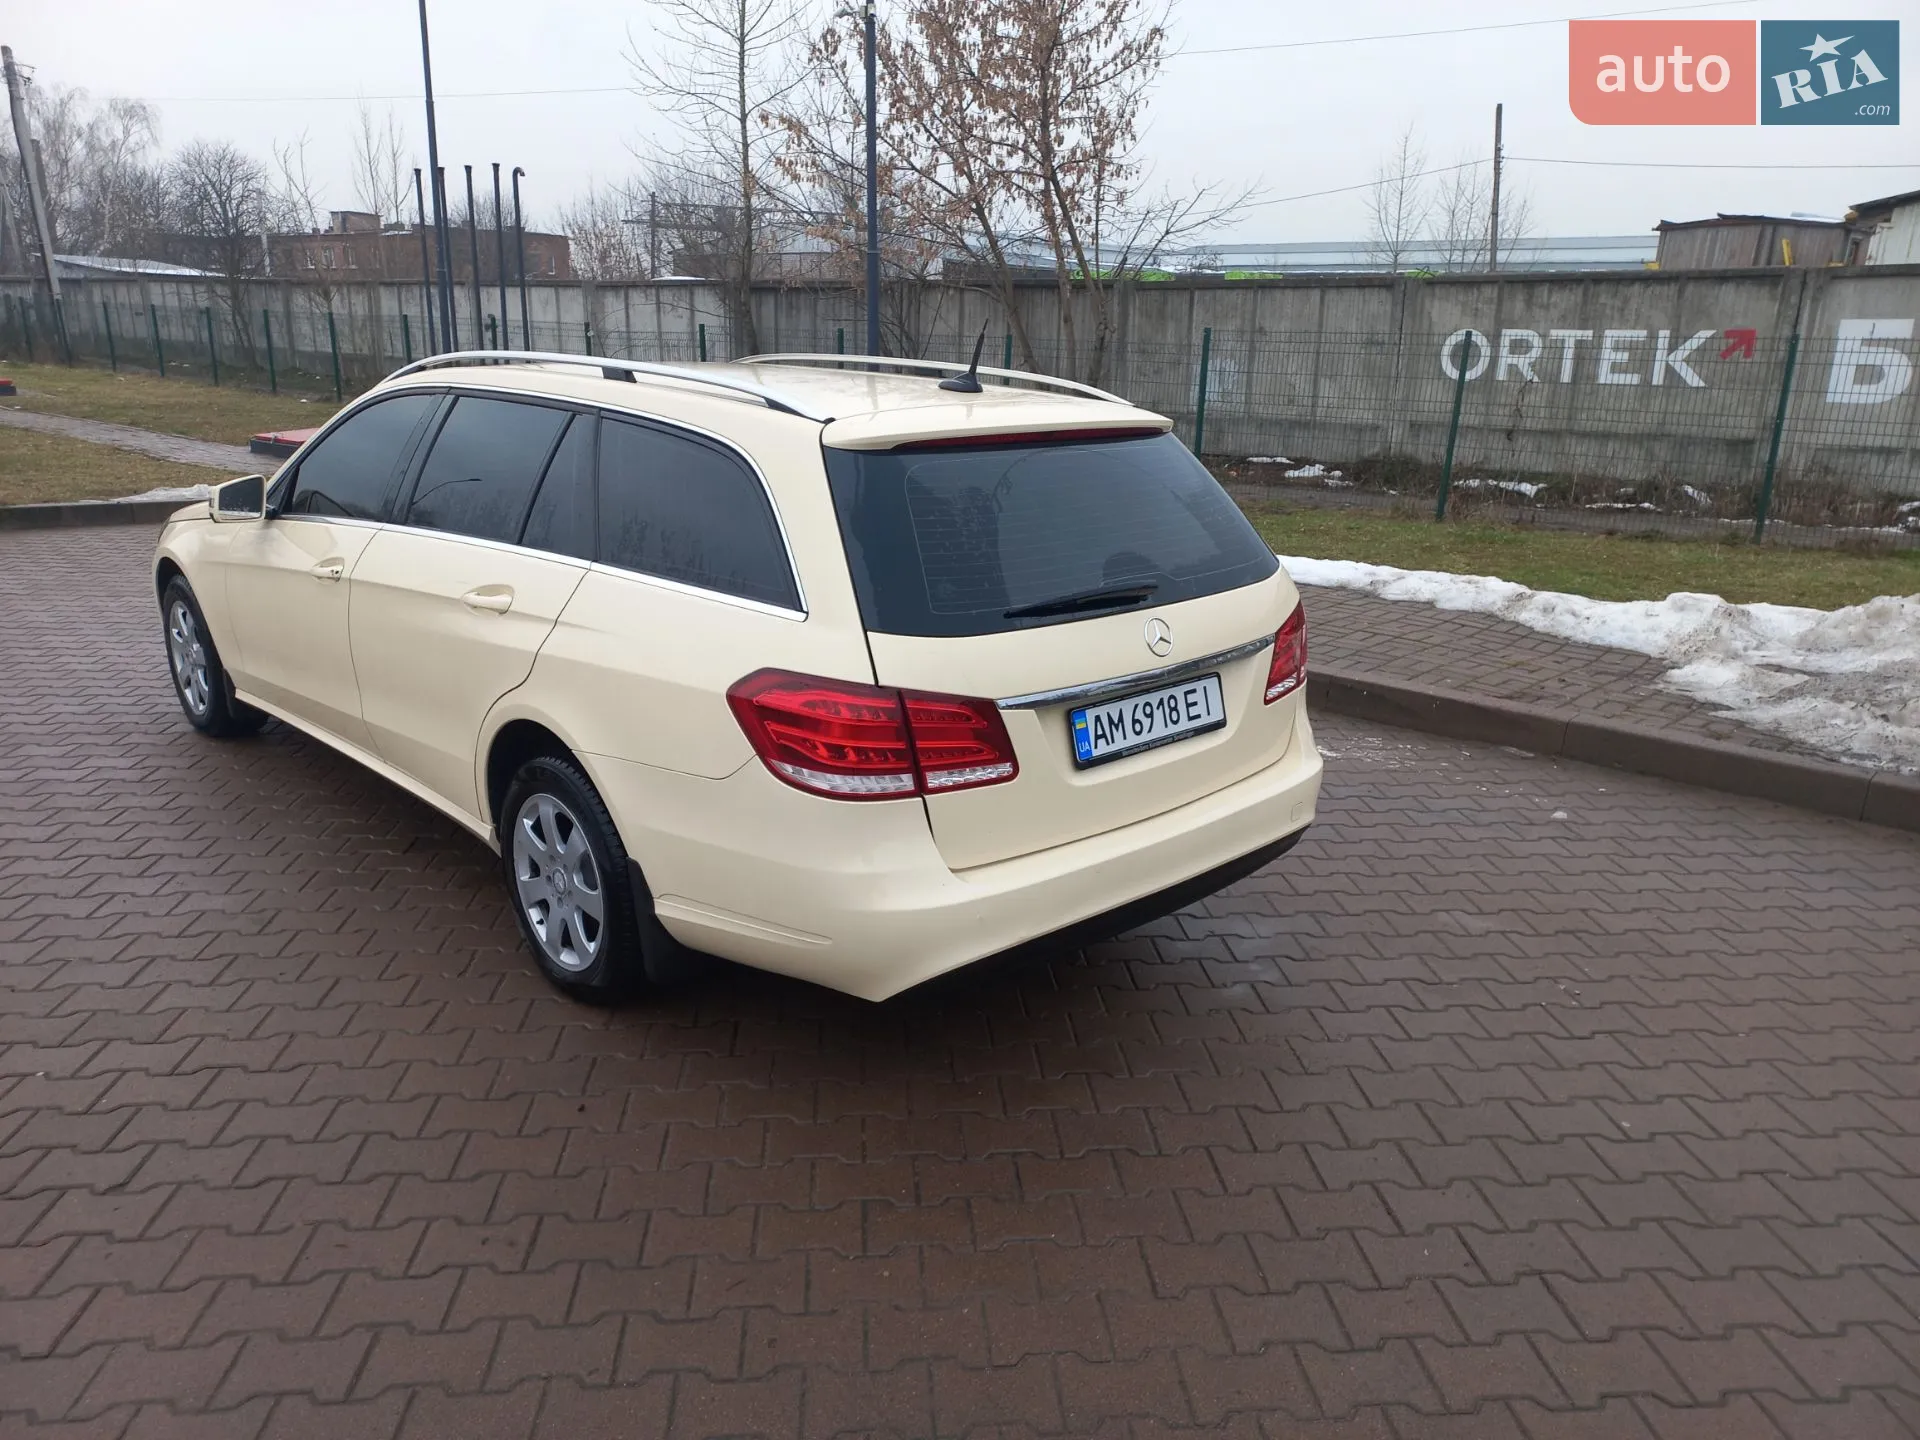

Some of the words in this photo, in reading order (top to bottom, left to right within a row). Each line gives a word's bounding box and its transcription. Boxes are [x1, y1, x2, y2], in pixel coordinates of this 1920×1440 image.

[1440, 328, 1717, 388] ORTEK
[1131, 694, 1181, 736] 6918
[1079, 742, 1091, 753] UA
